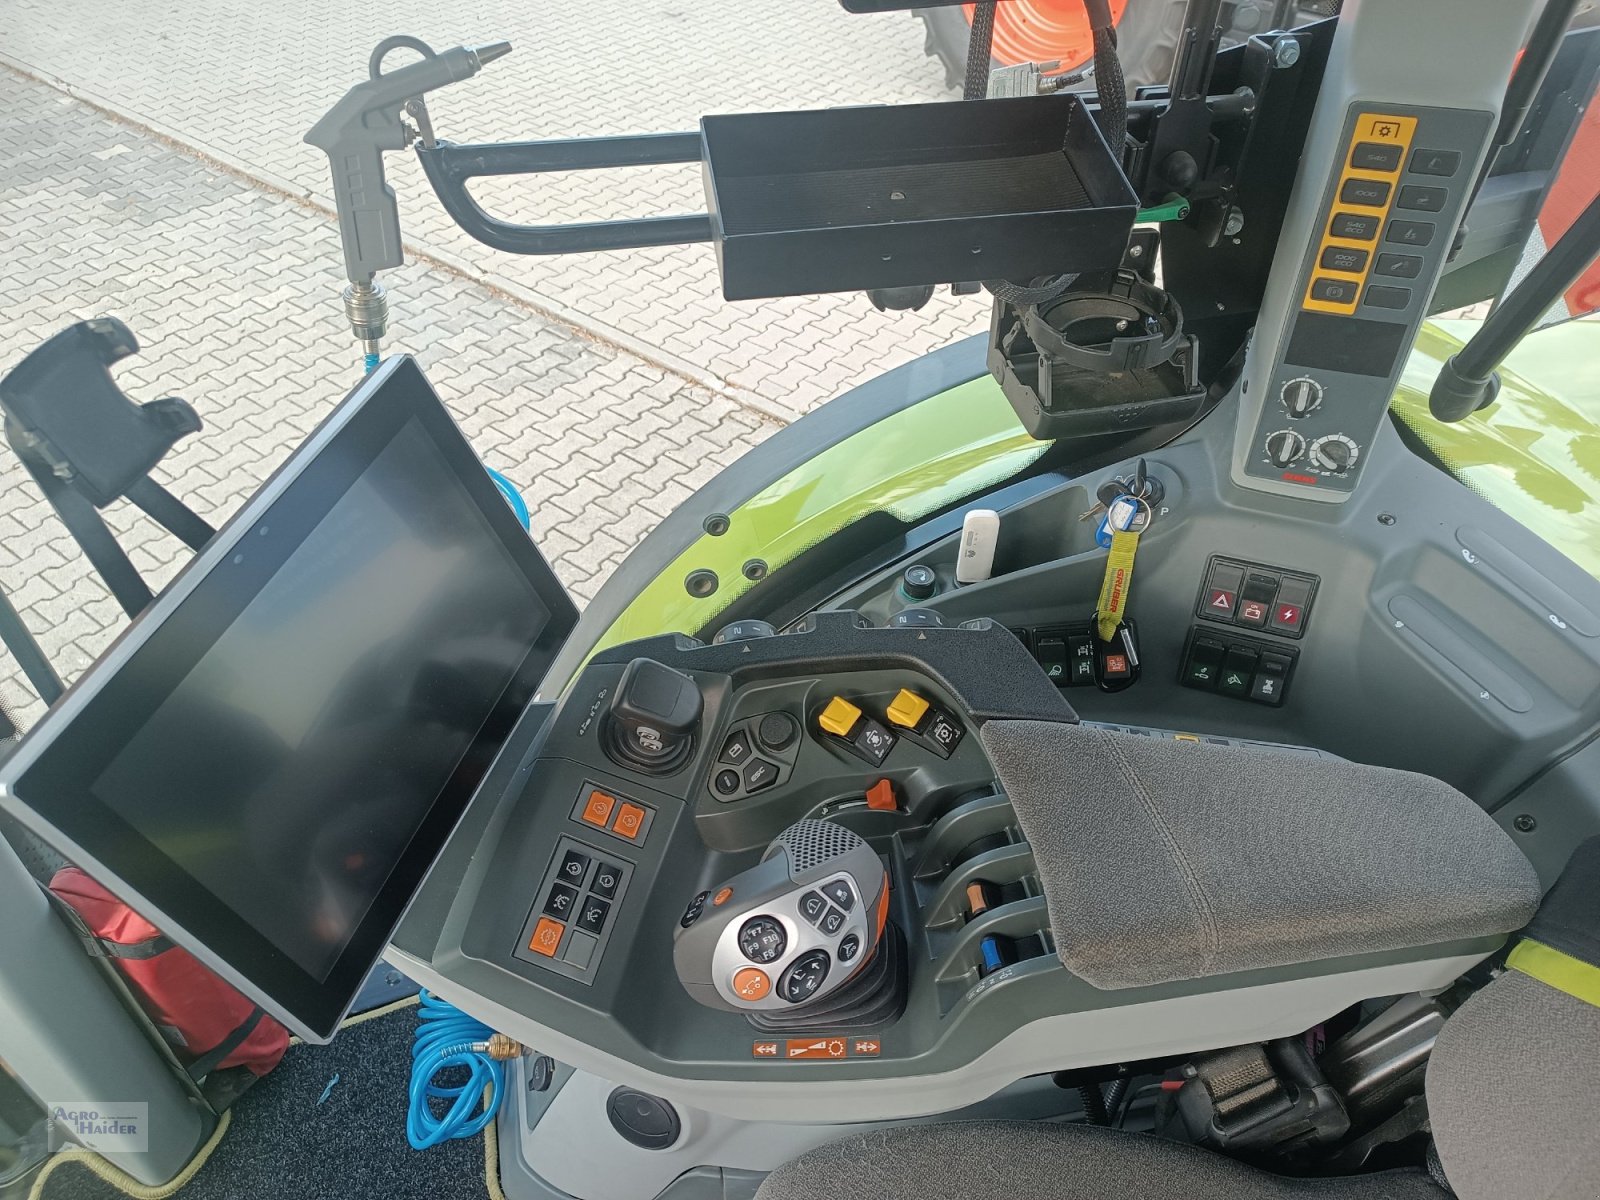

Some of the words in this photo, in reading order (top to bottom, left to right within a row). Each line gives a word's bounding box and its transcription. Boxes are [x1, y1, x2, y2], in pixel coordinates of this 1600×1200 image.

[1160, 507, 1169, 516] P
[1110, 569, 1124, 612] GRUBER
[830, 917, 838, 926] 2
[751, 926, 762, 936] F7
[762, 934, 778, 945] F10
[748, 942, 760, 954] F9
[762, 948, 776, 960] F8
